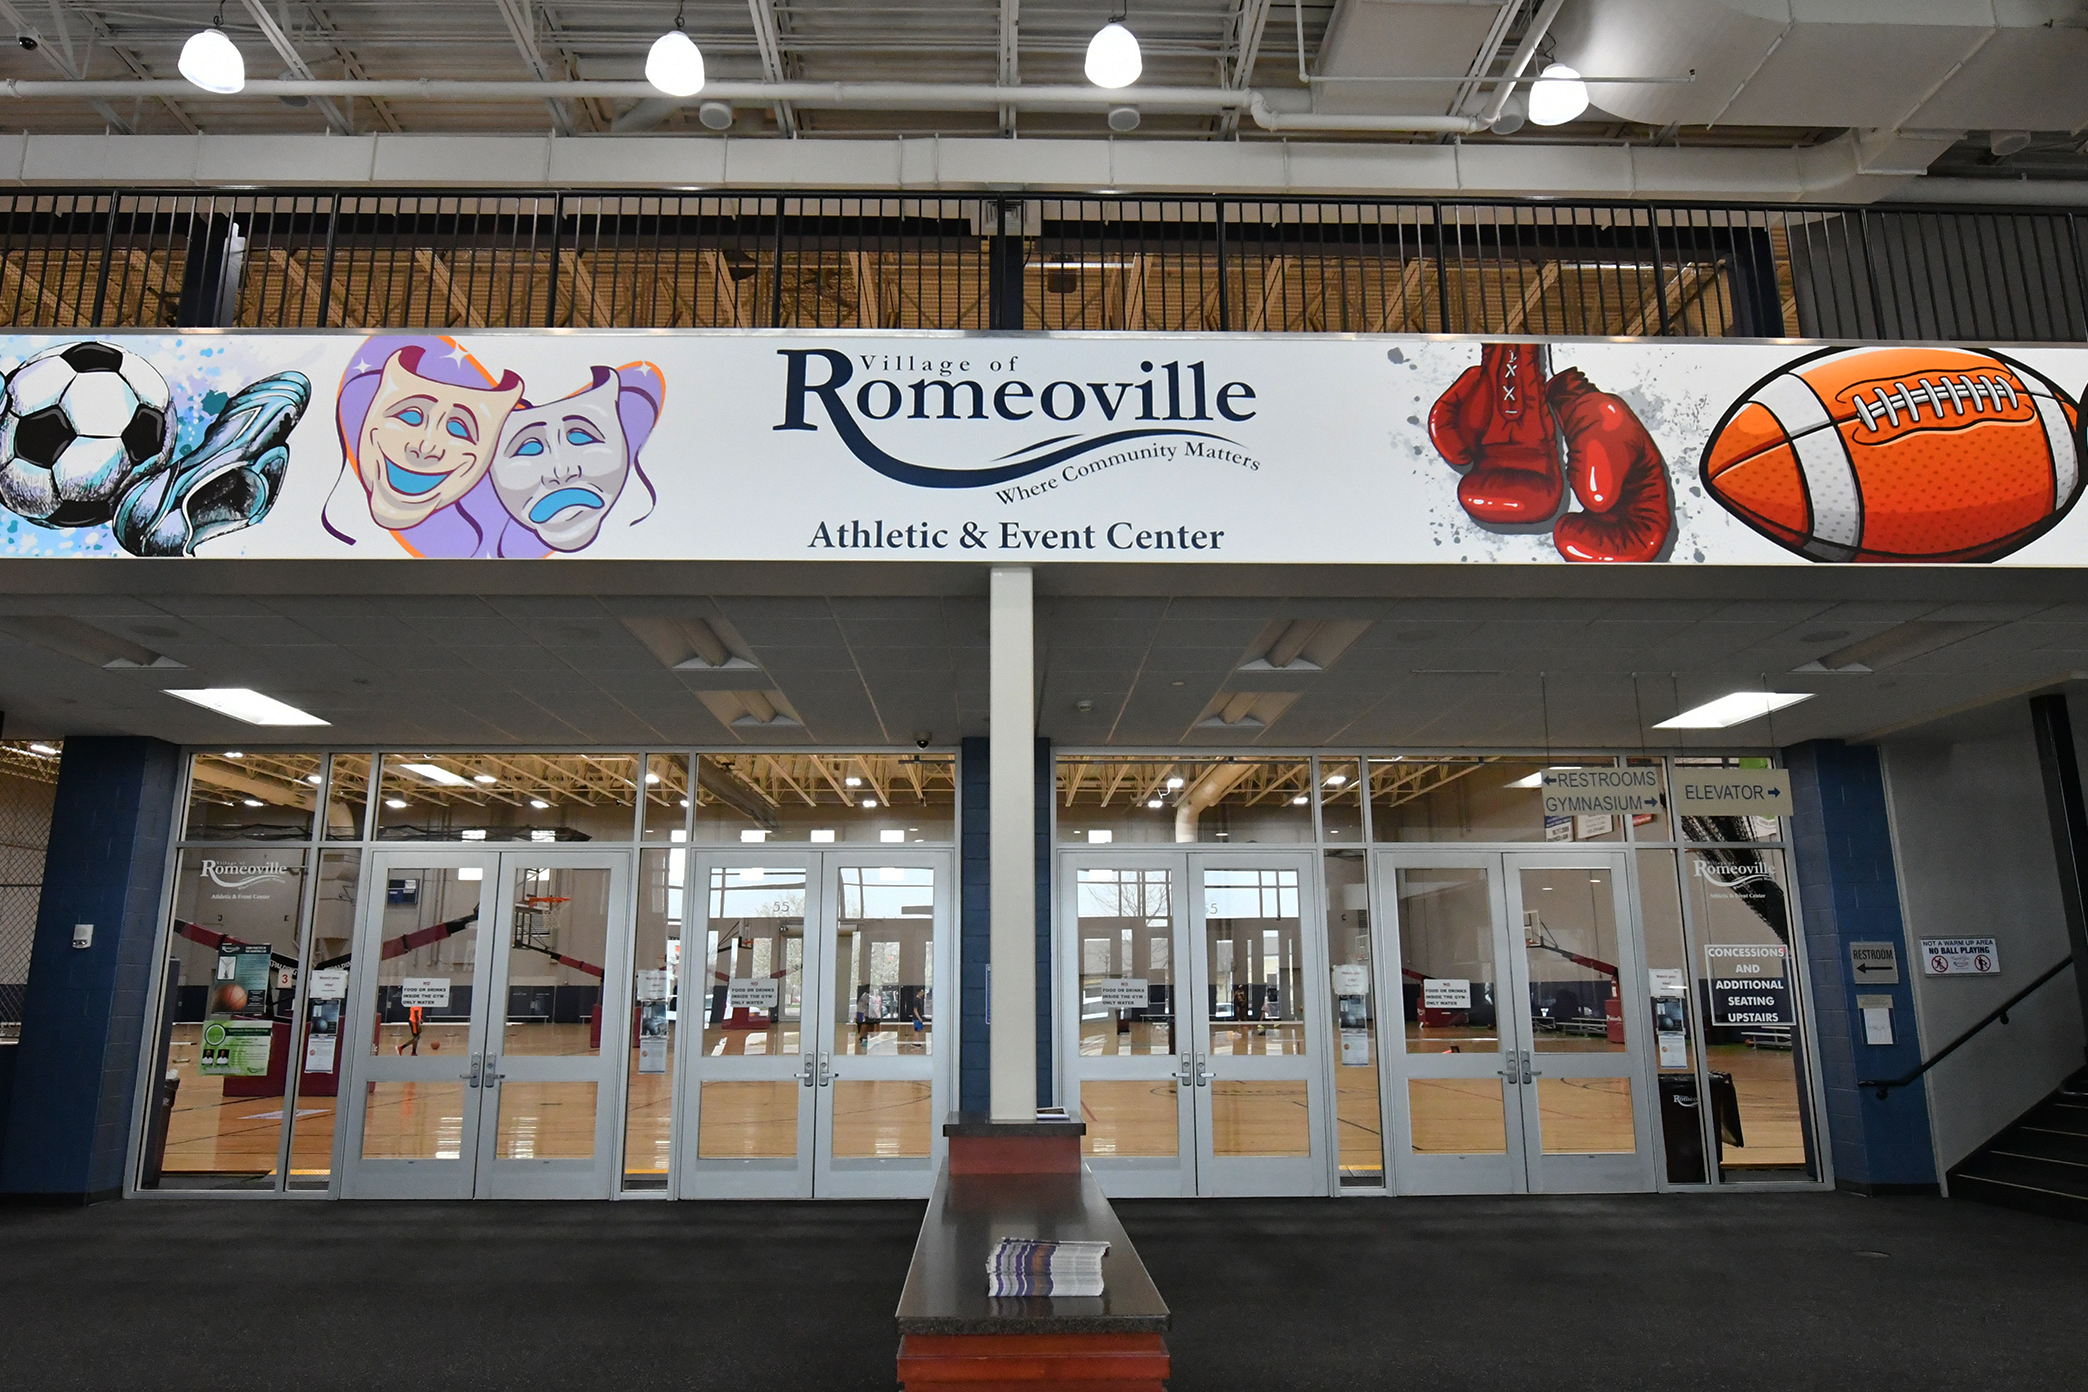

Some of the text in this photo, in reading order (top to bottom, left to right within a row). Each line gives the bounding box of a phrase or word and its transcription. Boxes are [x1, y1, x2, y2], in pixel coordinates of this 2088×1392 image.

[860, 354, 1019, 377] Village of
[772, 348, 1257, 432] Romeoville
[995, 440, 1261, 506] Where Community Matters
[807, 519, 1226, 550] Athletic & Event Center
[1557, 771, 1657, 788] RESTROOMS
[1685, 784, 1764, 800] ELEVATOR
[1545, 795, 1643, 812] GYMNASIUM
[200, 859, 287, 877] Romeoville
[1693, 859, 1776, 877] Romeoville
[772, 901, 790, 913] 55
[1708, 948, 1785, 957] CONCESSIONS
[1853, 949, 1894, 960] RESTROOM
[1928, 947, 1939, 955] NO
[1960, 946, 1990, 954] PLAYING
[1735, 964, 1760, 973] AND
[281, 973, 289, 984] 3
[1715, 980, 1784, 990] ADDITIONAL
[1728, 996, 1775, 1006] SEATING
[1728, 1012, 1779, 1022] UPSTAIRS
